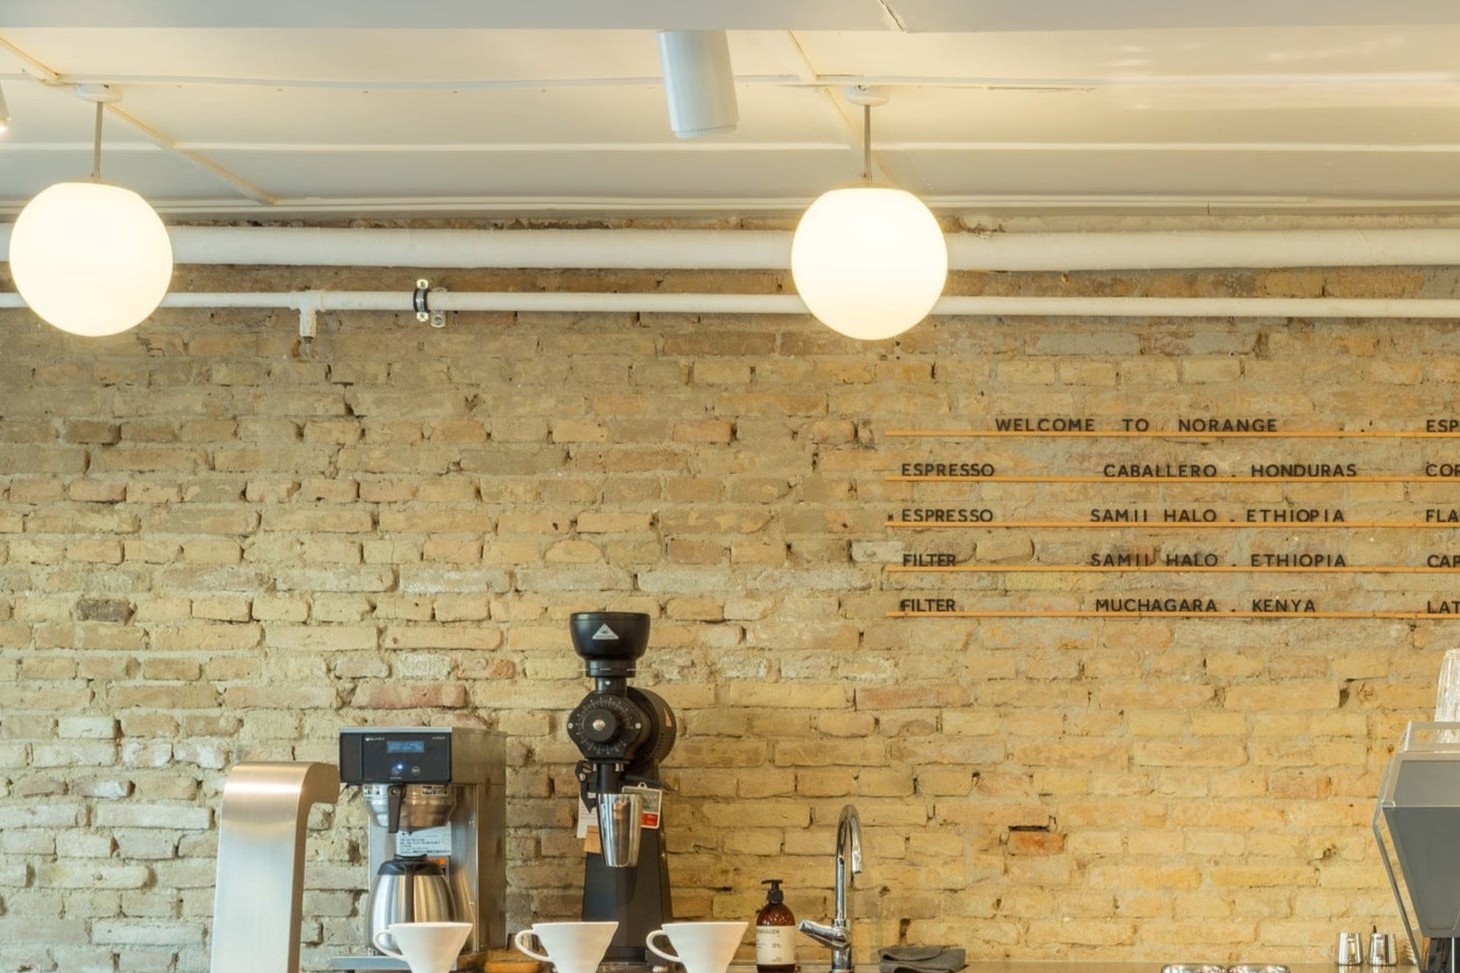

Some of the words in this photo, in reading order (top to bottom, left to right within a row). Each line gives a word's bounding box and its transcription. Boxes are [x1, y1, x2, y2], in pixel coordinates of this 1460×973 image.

[995, 418, 1095, 432] WELCOME
[1122, 418, 1149, 432] TO
[1178, 419, 1277, 432] NORANGE
[901, 463, 995, 476] ESPRESSO
[1103, 464, 1217, 477] CABALLERO
[1251, 464, 1357, 477] HONDURAS
[902, 509, 993, 522] ESPRESSO
[1091, 509, 1147, 522] SAMII
[1164, 509, 1217, 522] HALO
[1247, 509, 1344, 522] ETHIOPIA
[903, 554, 956, 567] FILTER
[1091, 554, 1149, 567] SAMII
[1166, 554, 1218, 567] HALO
[1250, 554, 1346, 567] ETHIOPIA
[902, 599, 956, 612] FILTER
[1095, 599, 1217, 612] MUCHAGARA
[1252, 599, 1316, 612] KENYA
